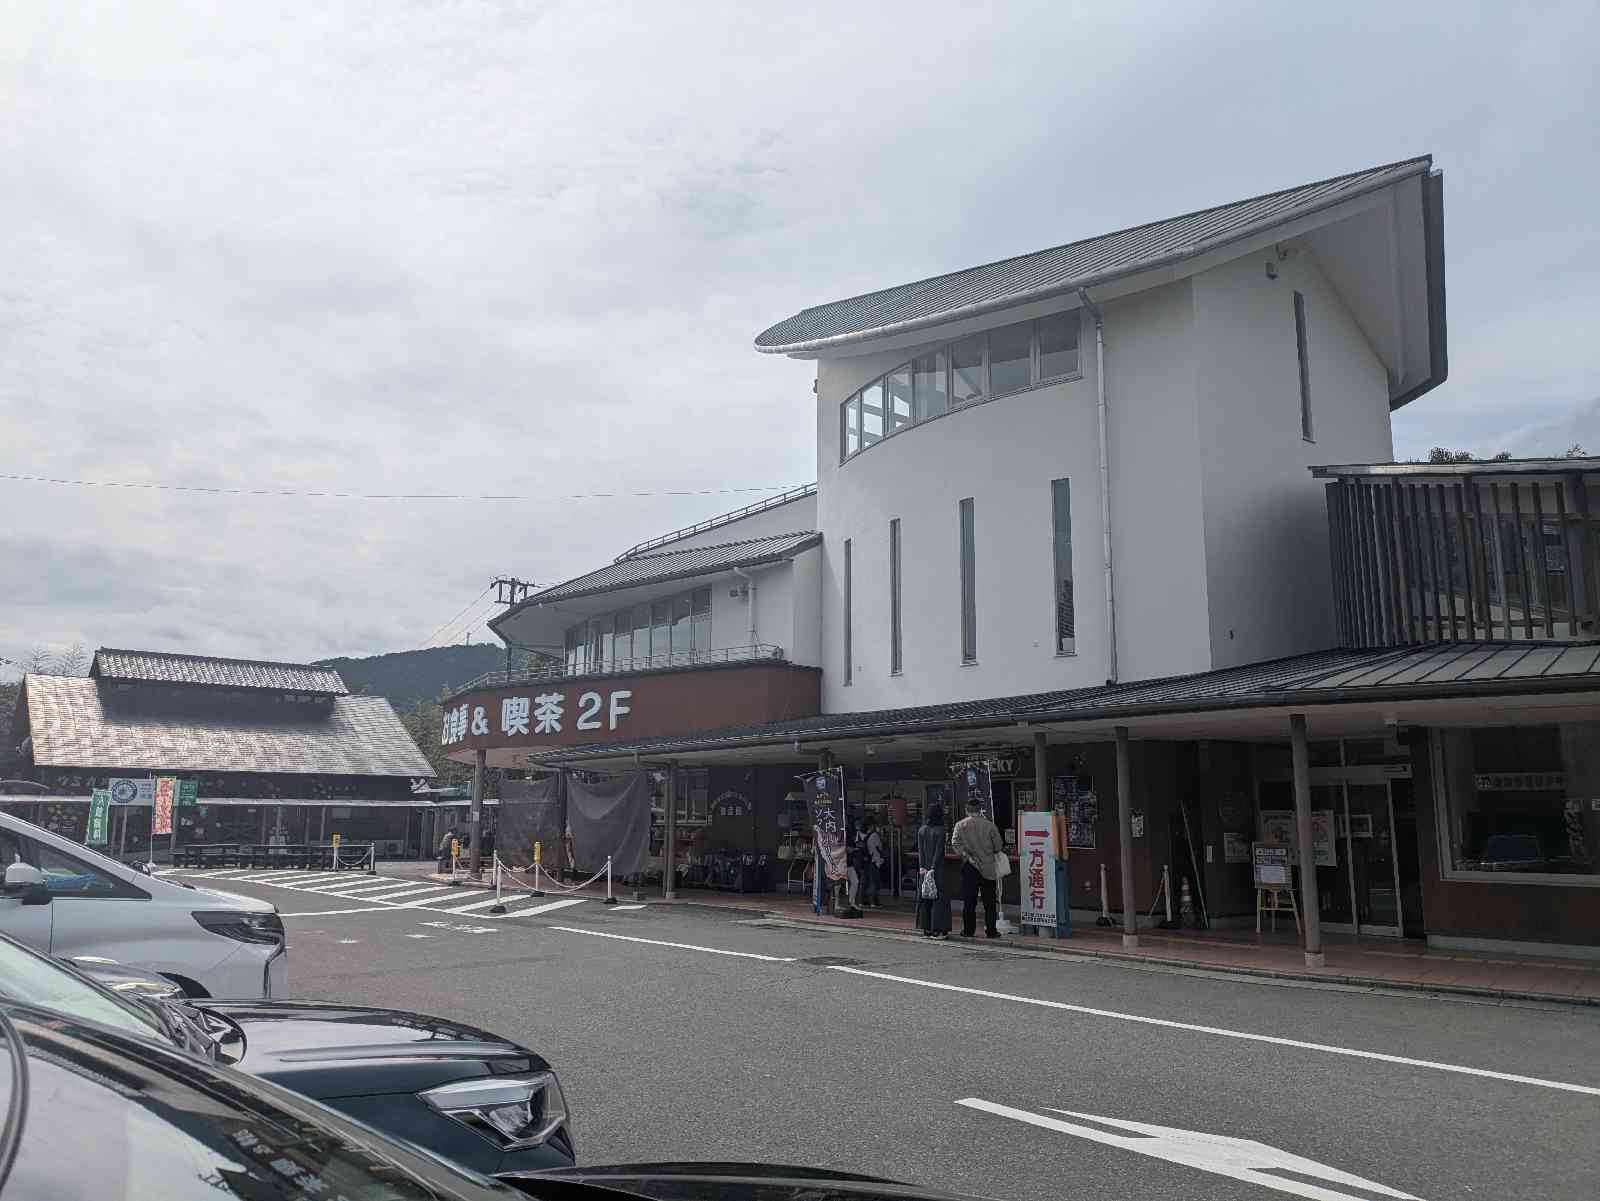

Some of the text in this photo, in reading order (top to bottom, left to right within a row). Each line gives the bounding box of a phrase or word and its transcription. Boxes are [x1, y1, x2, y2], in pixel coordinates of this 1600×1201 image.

[502, 692, 565, 736] 喫茶
[577, 690, 632, 730] 2F
[1029, 842, 1046, 909] 一方通行
